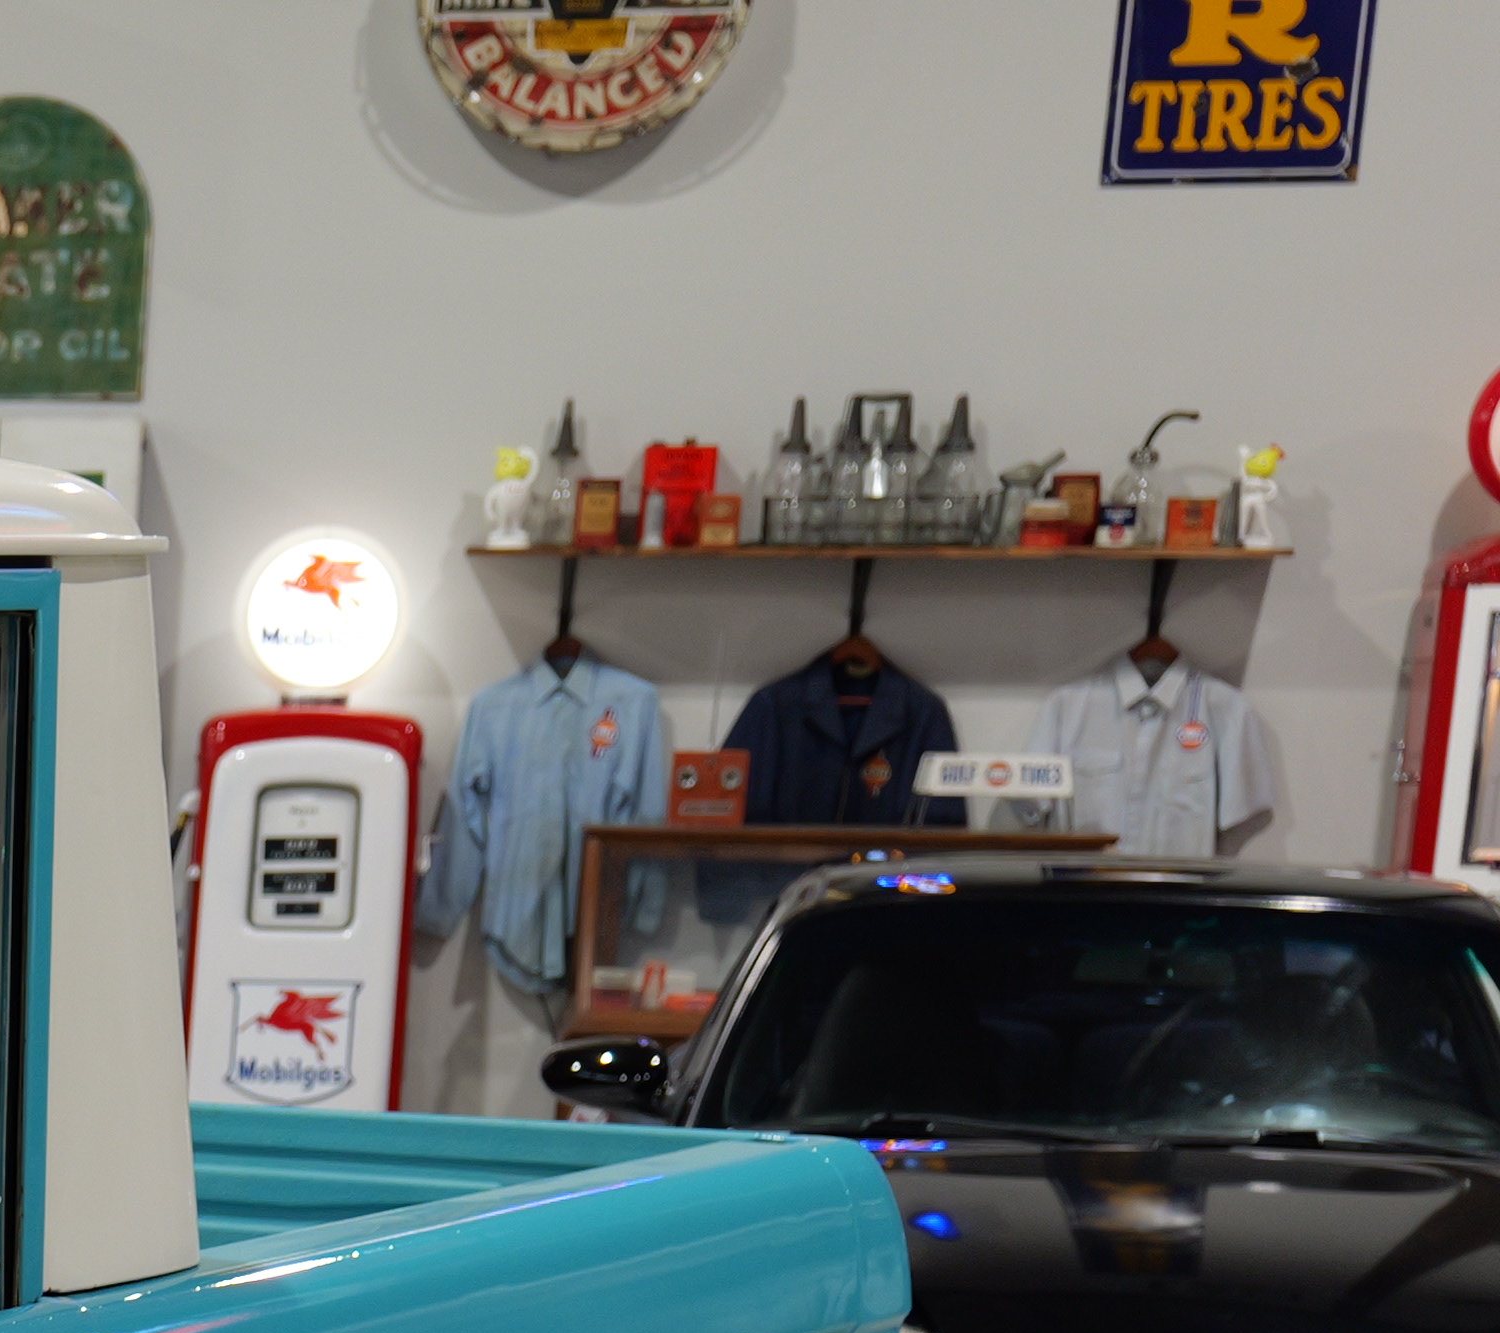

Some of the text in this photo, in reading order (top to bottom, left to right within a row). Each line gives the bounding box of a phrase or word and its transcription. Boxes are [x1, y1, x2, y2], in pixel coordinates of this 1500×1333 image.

[462, 31, 698, 120] BALANCED
[1128, 77, 1346, 152] TIRES
[58, 327, 131, 362] OIL
[239, 1058, 343, 1090] Mobilgas
